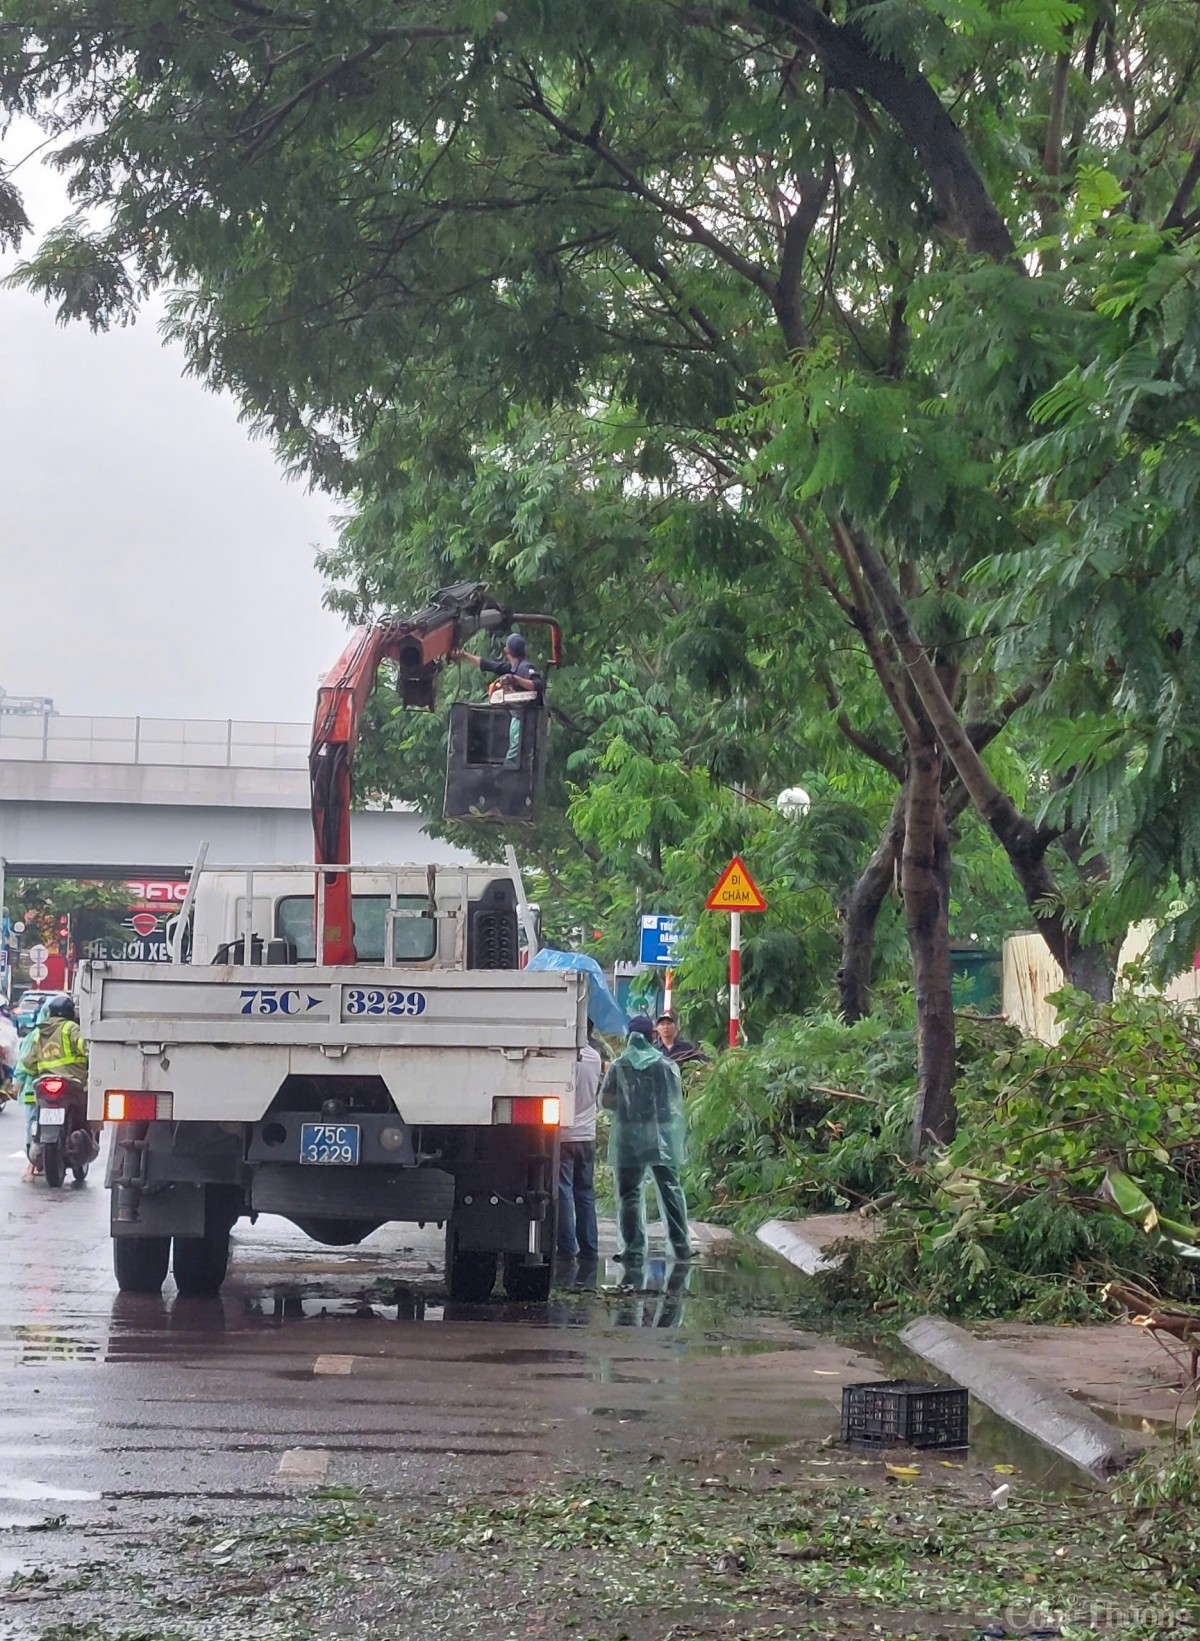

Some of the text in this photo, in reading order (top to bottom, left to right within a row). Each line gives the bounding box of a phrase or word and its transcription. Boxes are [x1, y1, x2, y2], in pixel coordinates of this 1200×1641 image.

[731, 875, 741, 885] ĐI
[148, 942, 167, 960] XE
[239, 990, 426, 1015] 75C 3229
[313, 1126, 347, 1144] 75C
[307, 1145, 352, 1163] 3229
